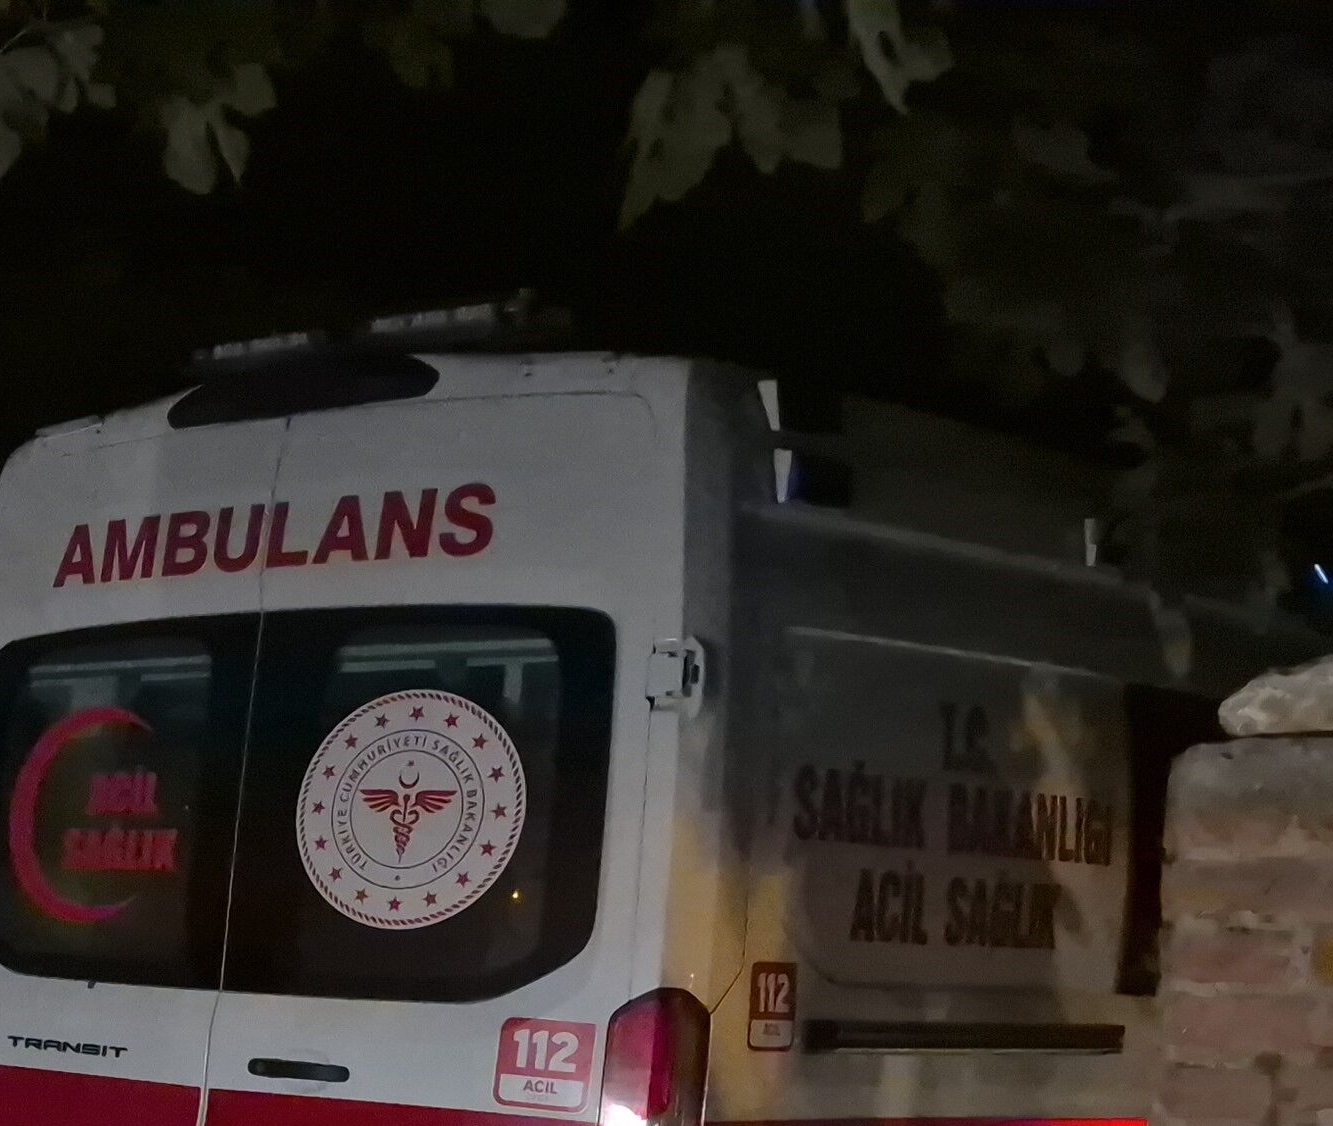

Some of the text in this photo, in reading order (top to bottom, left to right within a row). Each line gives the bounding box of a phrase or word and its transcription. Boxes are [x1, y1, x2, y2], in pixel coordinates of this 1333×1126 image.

[53, 482, 497, 588] AMBULANS
[431, 737, 474, 785] SAĞLIK
[793, 760, 928, 849] SAĞLIK
[432, 788, 479, 873] BAKANLIĞI
[757, 972, 791, 1013] 112
[7, 1035, 129, 1058] TRANSIT
[513, 1028, 580, 1074] 112
